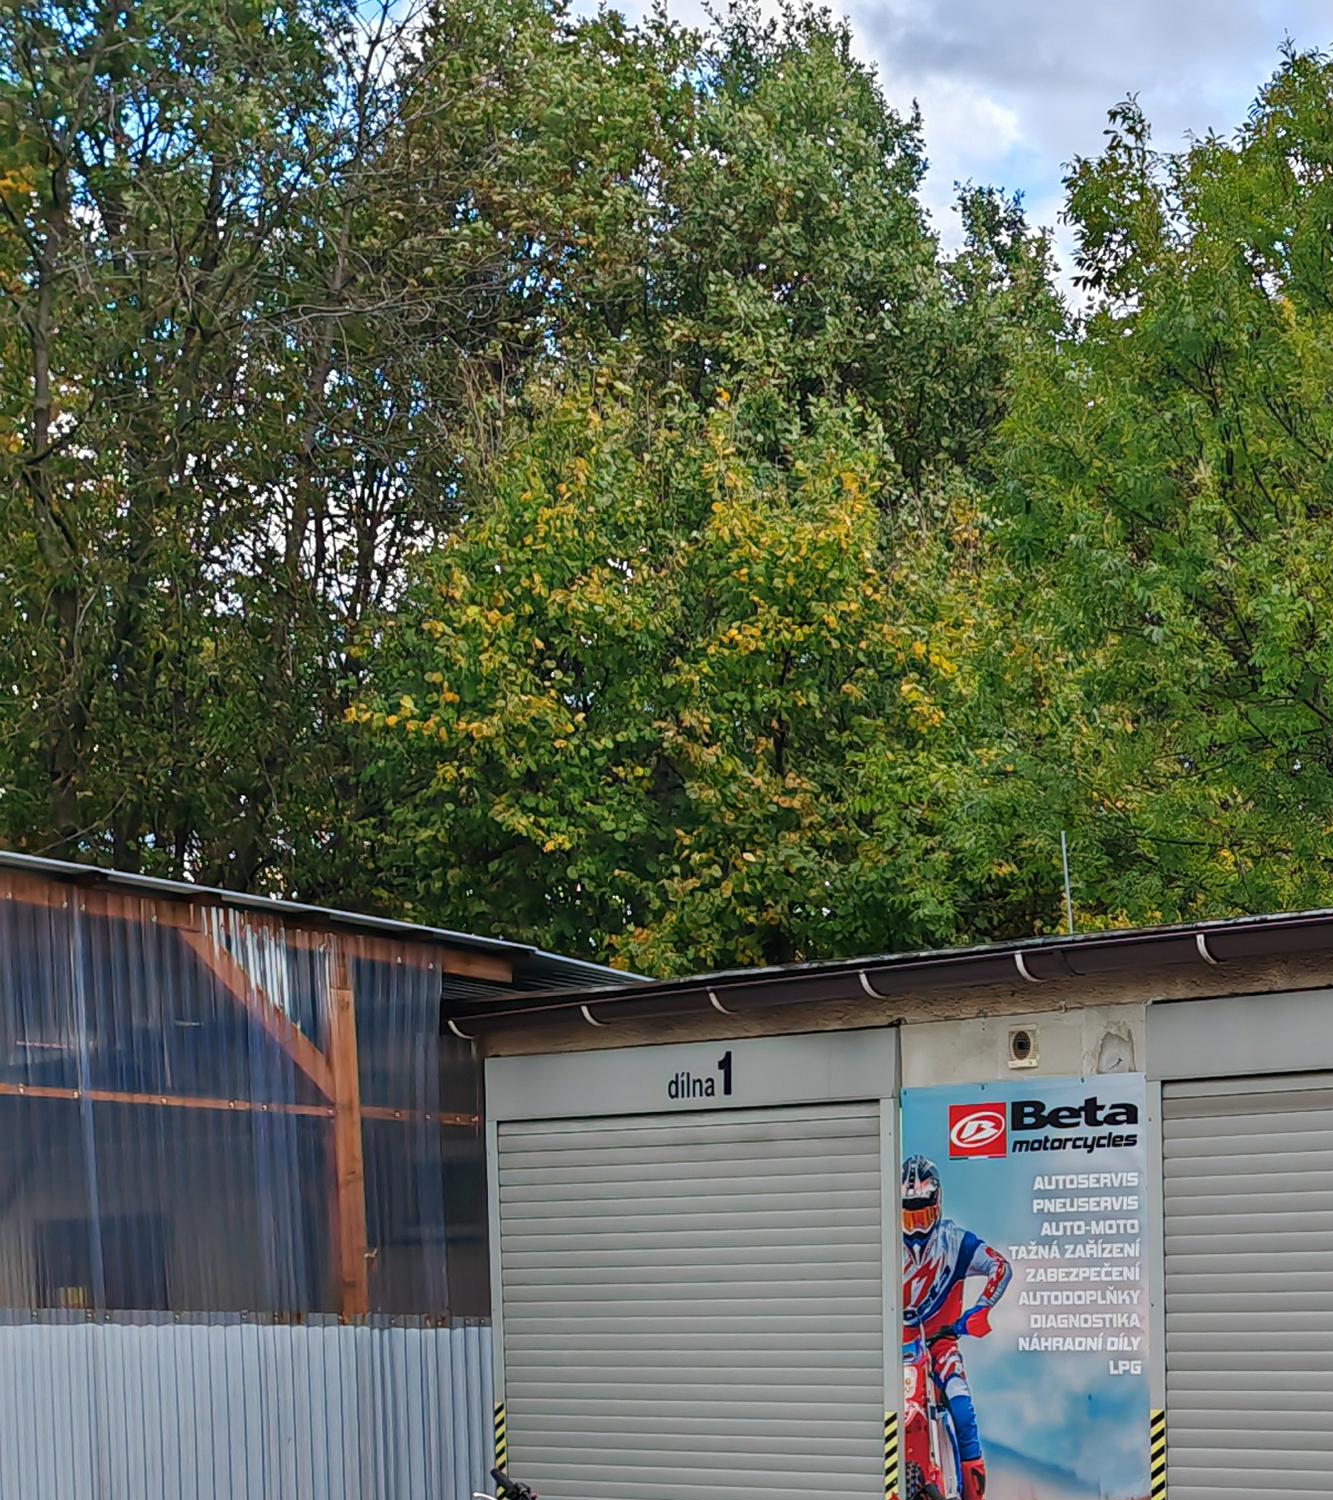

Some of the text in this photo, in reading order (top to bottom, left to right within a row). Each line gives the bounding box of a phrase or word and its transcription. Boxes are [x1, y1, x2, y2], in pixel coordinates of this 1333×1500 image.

[668, 1050, 732, 1099] dílna 1
[1010, 1096, 1139, 1132] Beta
[1011, 1132, 1139, 1154] motorcycles
[1032, 1172, 1139, 1191] AUTOSERVIS
[1032, 1195, 1139, 1214] PNEUSERVIS
[1040, 1219, 1140, 1237] AUTO-MOTO
[1008, 1238, 1141, 1260] TAŽNÁ ZAŘÍZENÍ
[1025, 1262, 1141, 1283] ZABEZPEČENÍ
[1018, 1285, 1141, 1305] AUTODOPLŇKY
[1030, 1313, 1141, 1329] DIAGNOSTIKA
[1018, 1332, 1142, 1352] NÁHRADNÍ DÍLY
[1108, 1359, 1143, 1376] LPG
